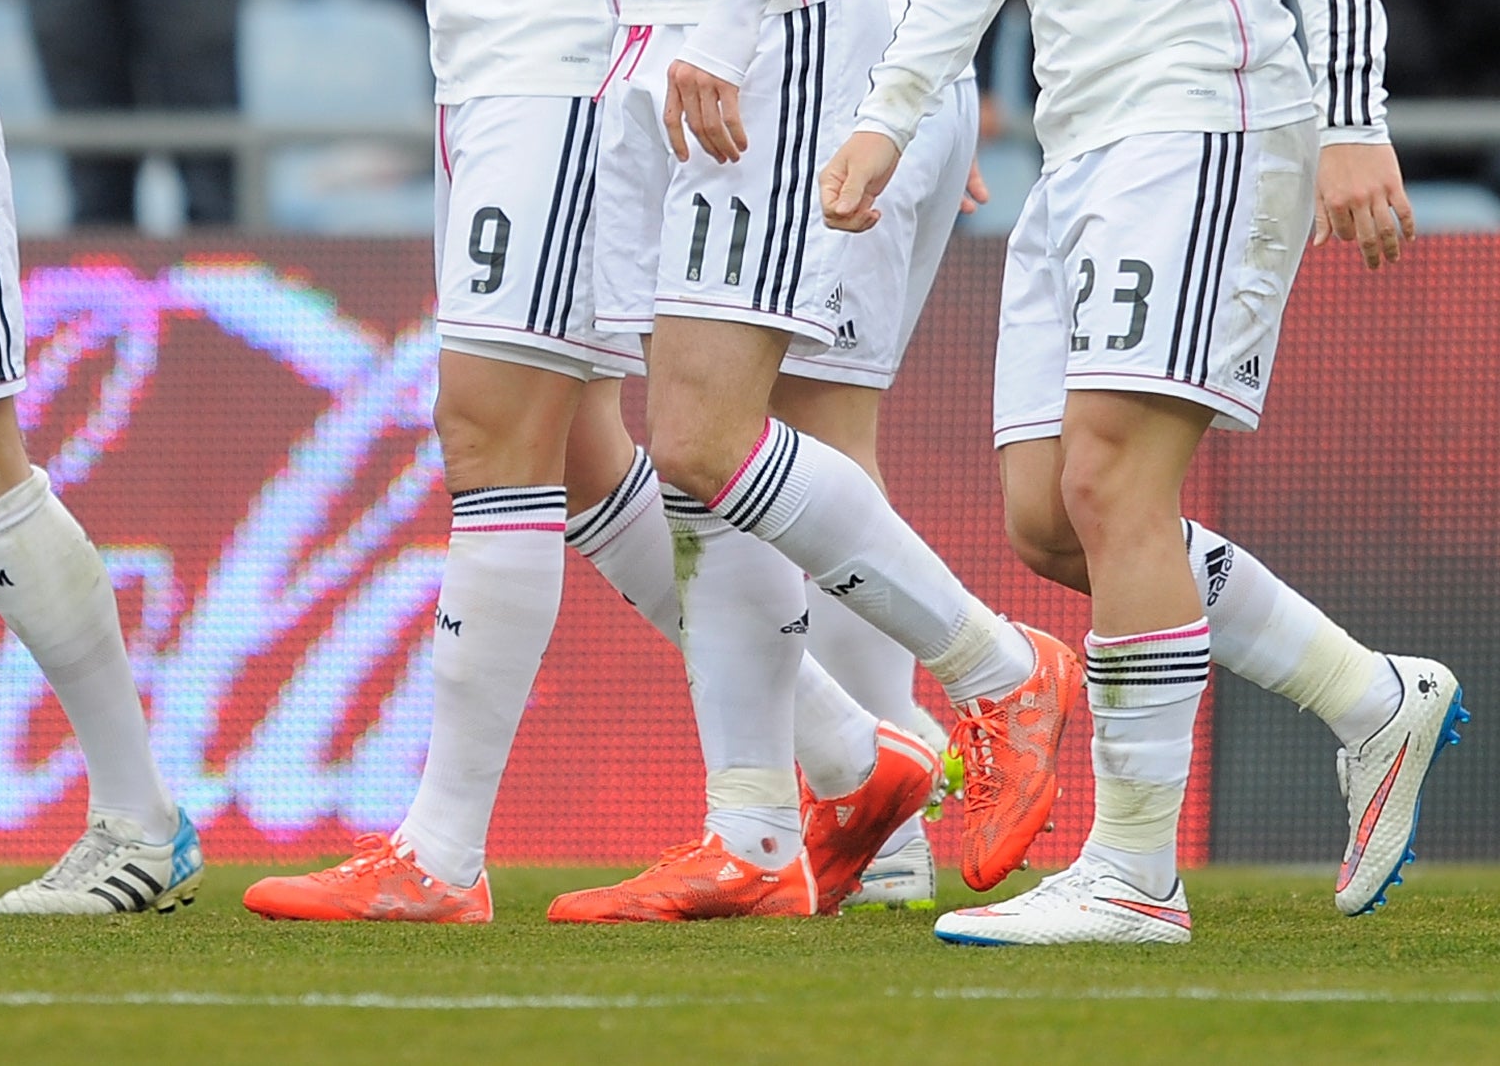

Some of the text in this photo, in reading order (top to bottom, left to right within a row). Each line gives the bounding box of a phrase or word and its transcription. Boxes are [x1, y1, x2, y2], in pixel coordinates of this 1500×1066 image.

[469, 206, 511, 294] 9
[685, 192, 751, 285] 11
[1070, 258, 1155, 352] 23
